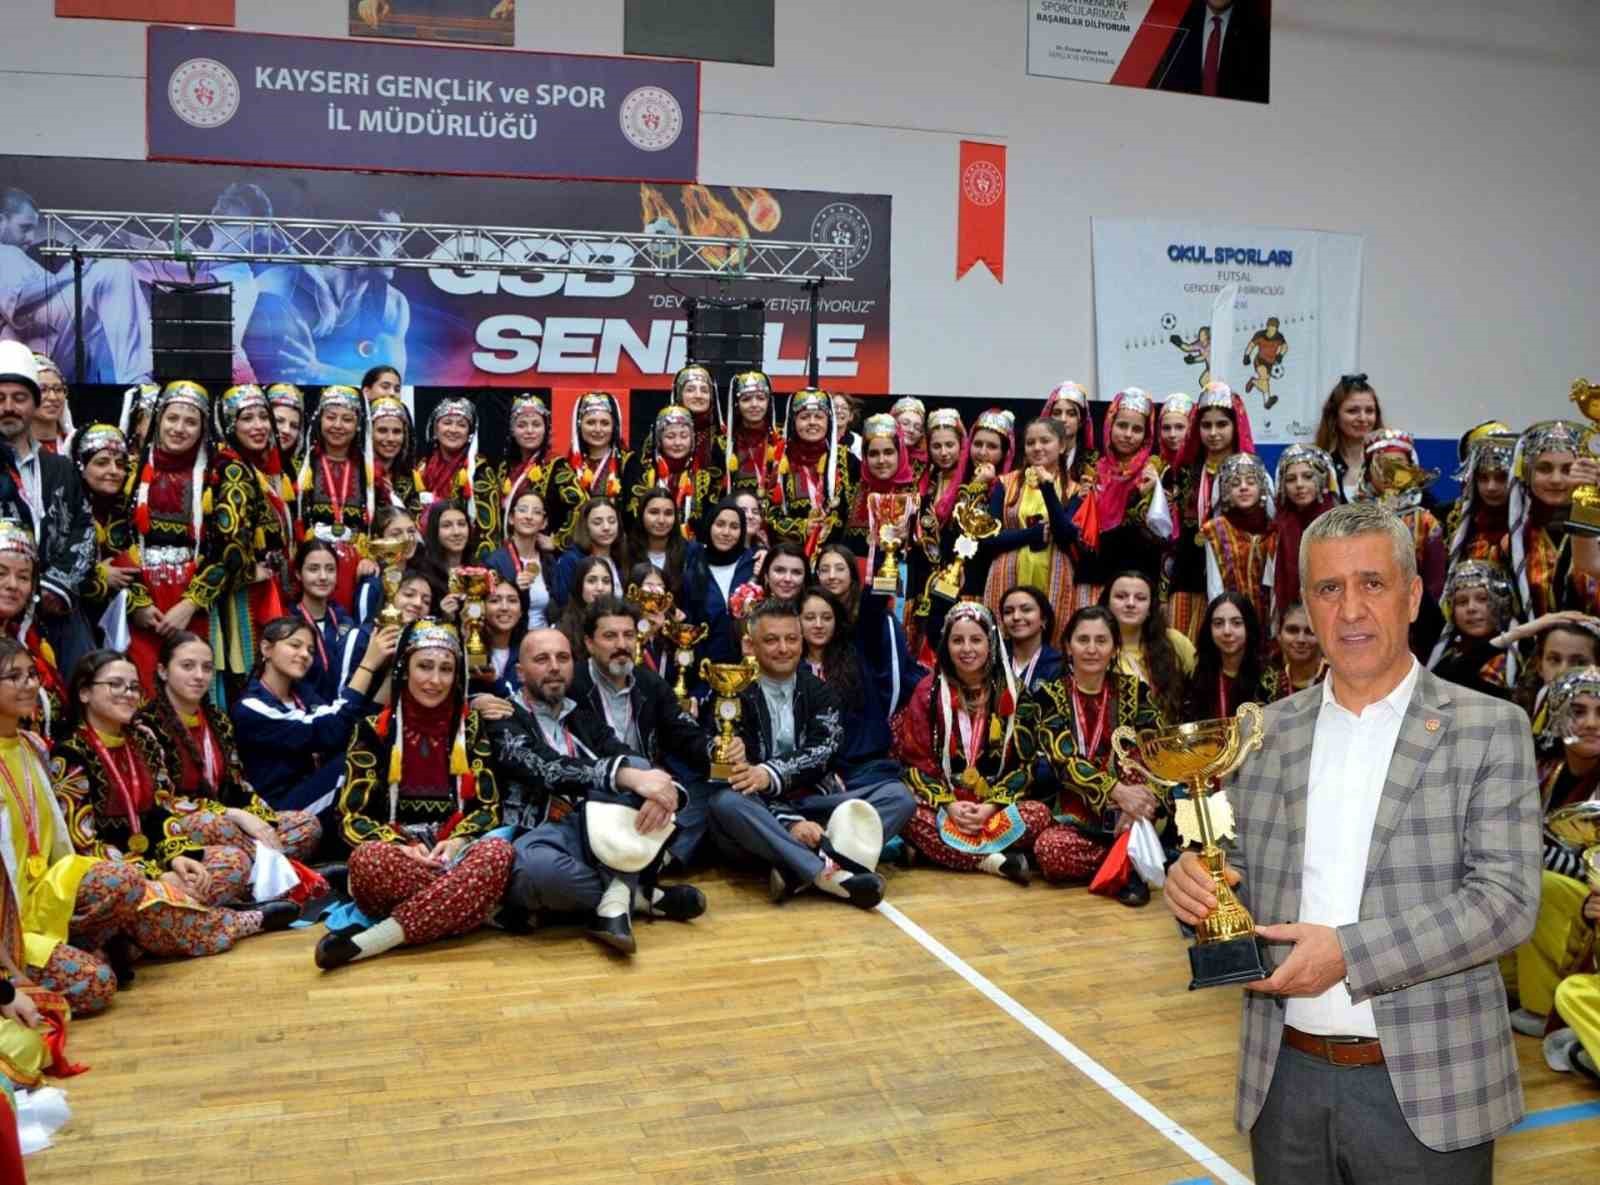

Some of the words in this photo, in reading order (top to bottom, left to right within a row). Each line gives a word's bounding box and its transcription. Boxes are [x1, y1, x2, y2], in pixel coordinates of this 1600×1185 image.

[499, 87, 529, 104] ve
[536, 84, 606, 109] SPOR
[327, 102, 352, 131] İL
[358, 106, 538, 140] MÜDÜRLÜĞÜ
[428, 234, 636, 298] GSB
[1167, 245, 1213, 264] OKUL
[1214, 247, 1293, 267] SPORLARI
[1217, 271, 1252, 281] FUTSAL
